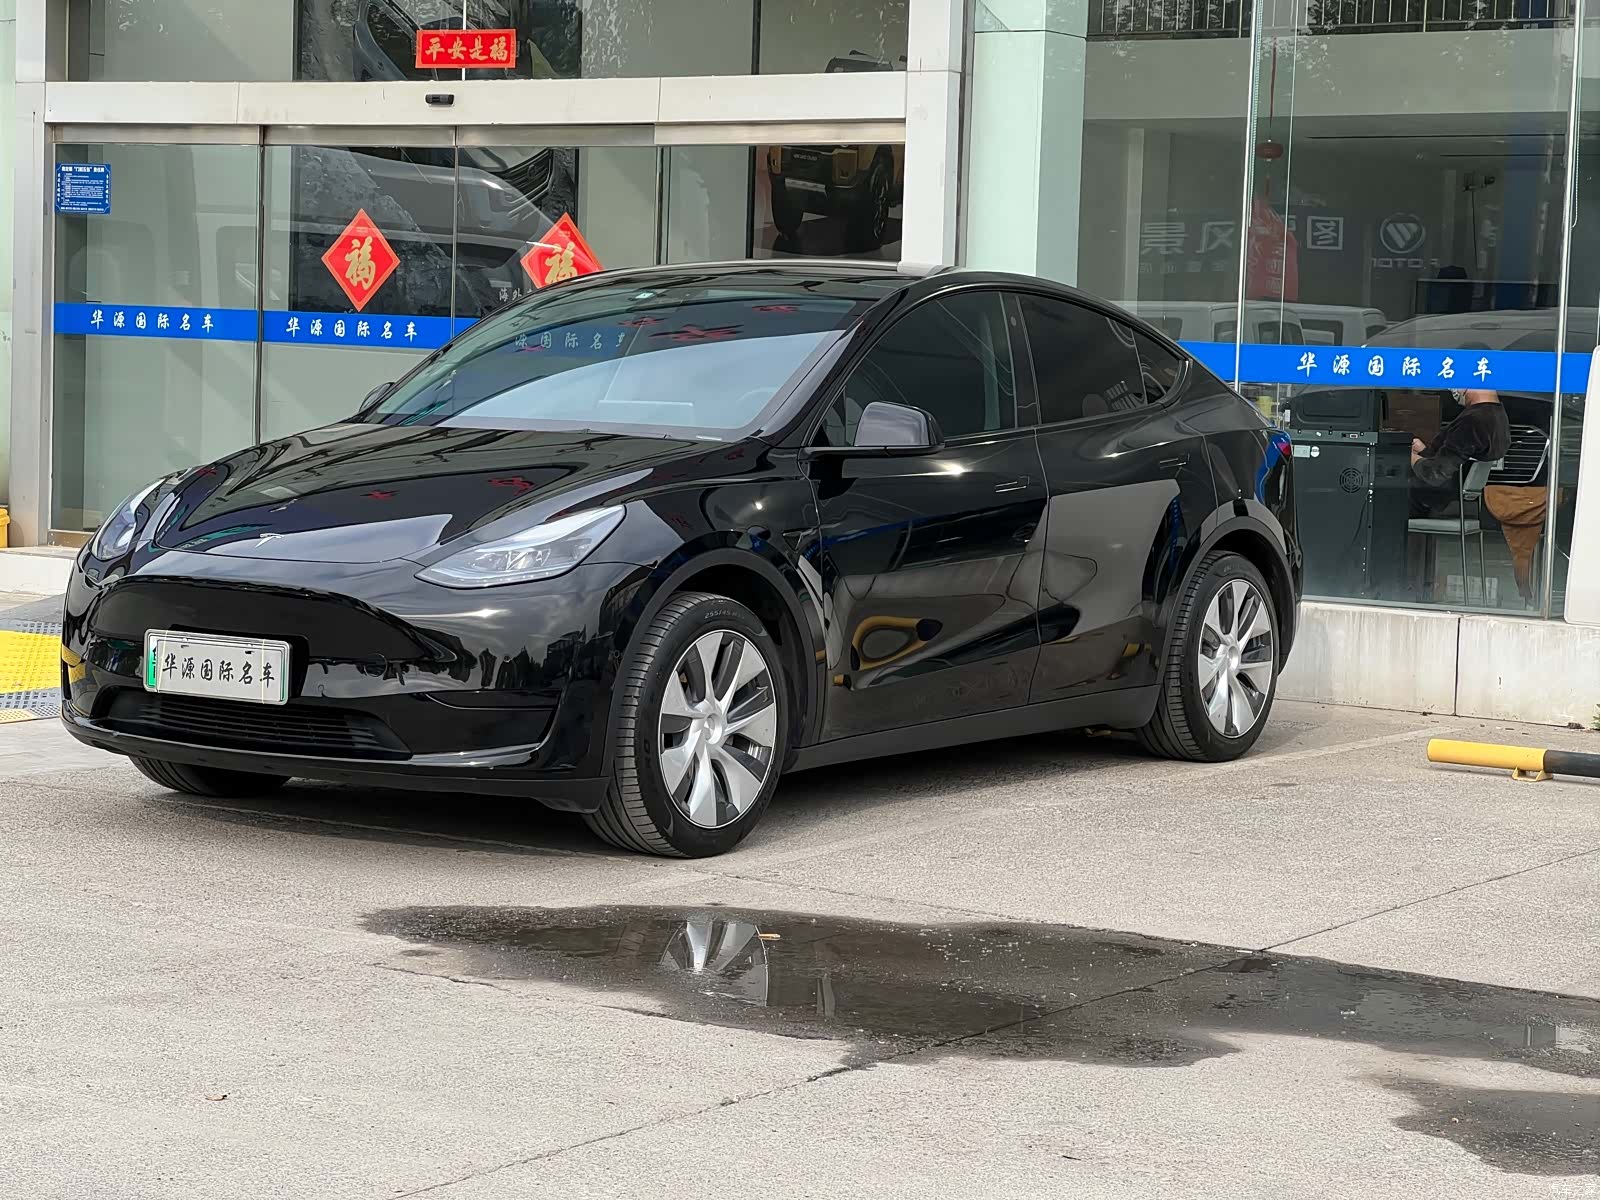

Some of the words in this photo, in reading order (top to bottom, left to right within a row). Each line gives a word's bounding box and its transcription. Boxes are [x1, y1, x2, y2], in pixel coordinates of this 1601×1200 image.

[424, 36, 508, 61] 平安是福
[344, 238, 377, 290] 福
[545, 242, 579, 280] 福
[90, 309, 214, 332] 华源国际名车
[286, 316, 418, 342] 华源国际名车
[1297, 351, 1492, 382] 华源国际名车
[162, 652, 275, 688] 华源国际名车
